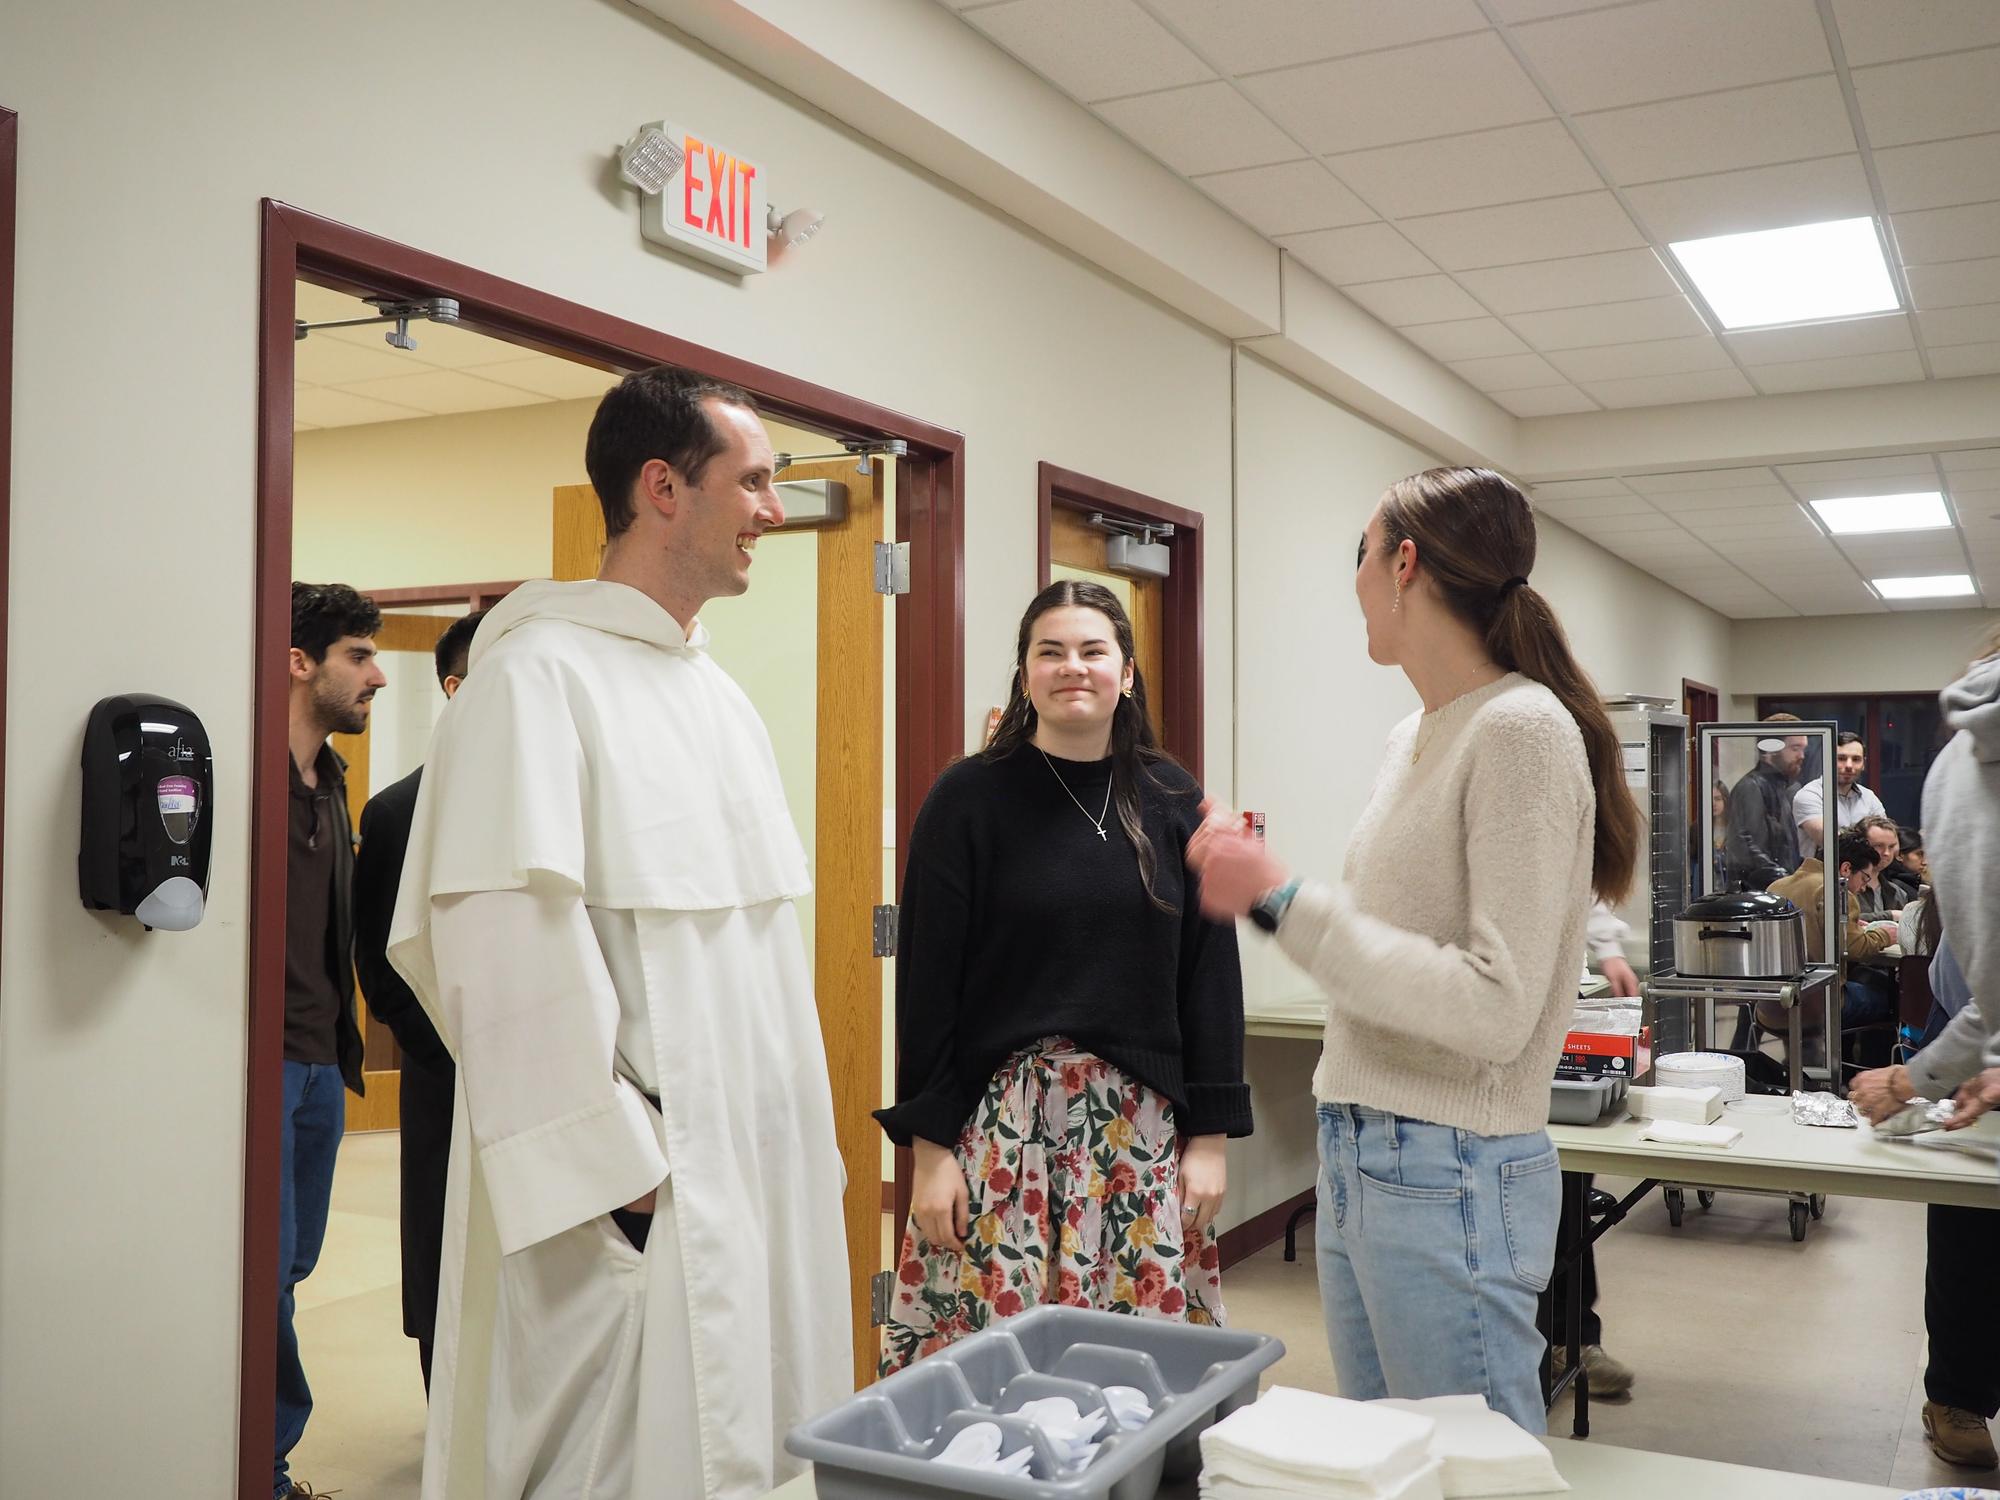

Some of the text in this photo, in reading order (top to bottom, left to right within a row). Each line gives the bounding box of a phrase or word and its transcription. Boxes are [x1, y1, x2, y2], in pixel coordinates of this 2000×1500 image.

[684, 135, 756, 249] EXIT
[168, 737, 193, 761] afia
[1254, 813, 1265, 824] FIRE
[1567, 1043, 1591, 1051] SHEETS
